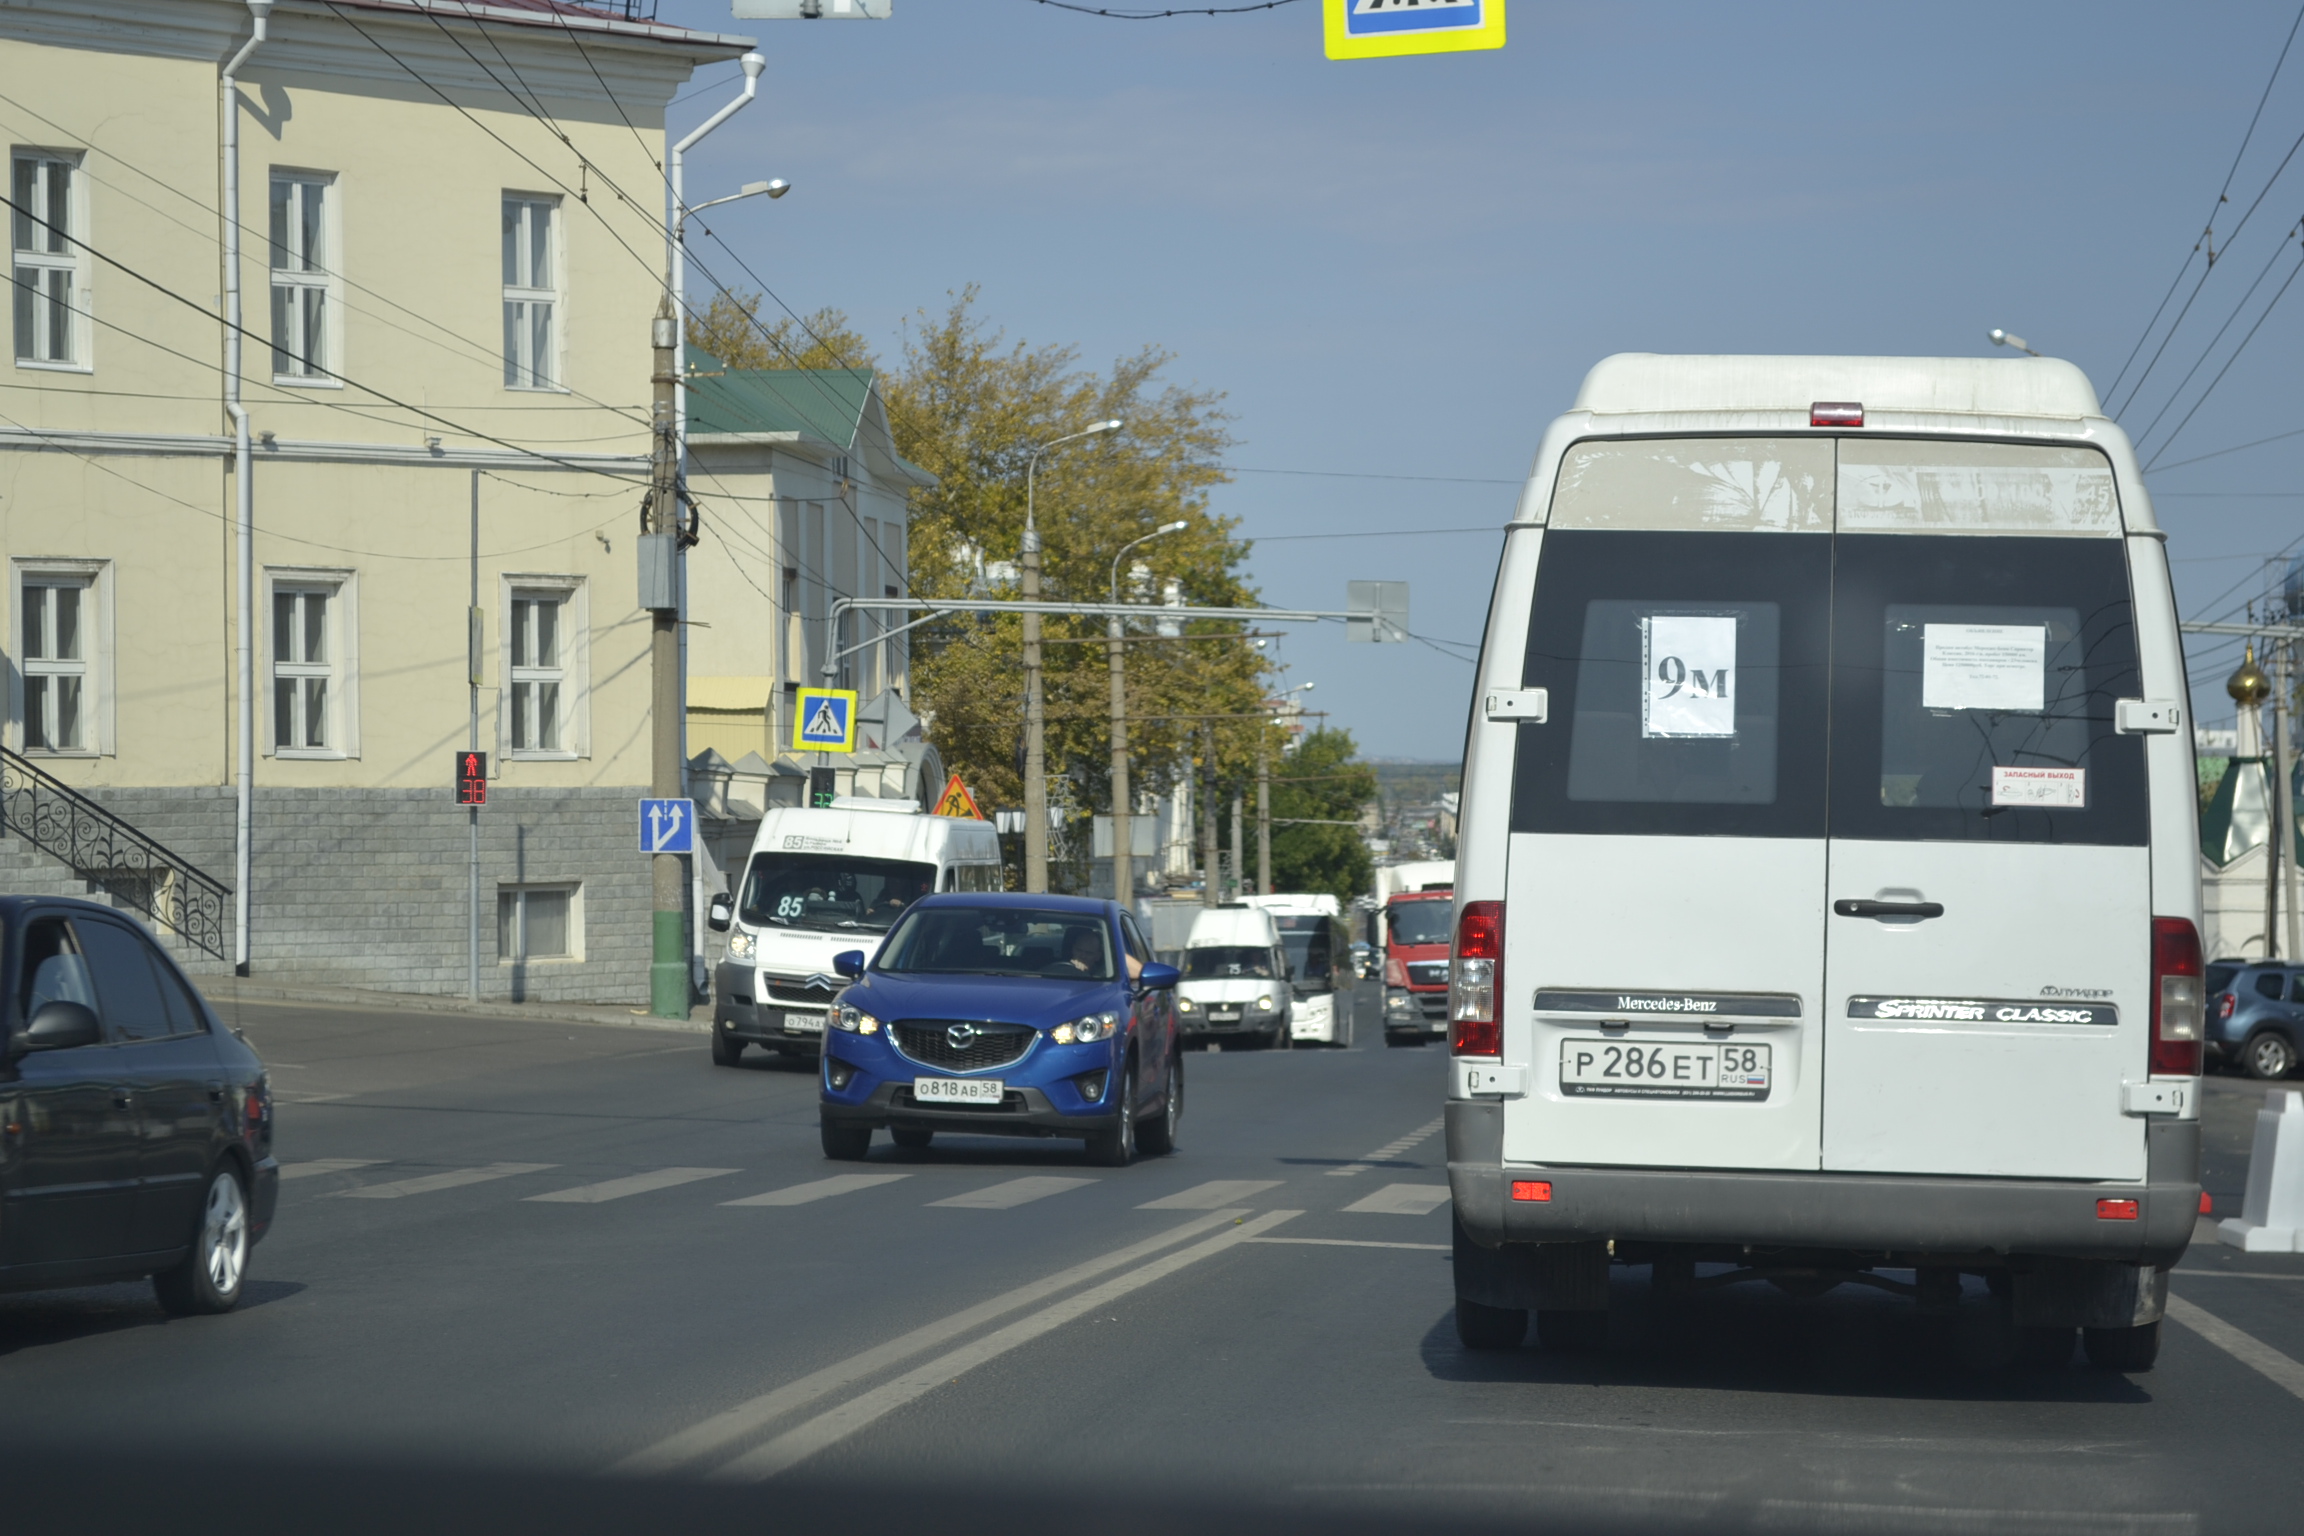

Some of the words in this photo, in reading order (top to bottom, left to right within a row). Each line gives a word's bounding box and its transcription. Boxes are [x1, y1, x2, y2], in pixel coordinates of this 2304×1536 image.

[2003, 771, 2045, 779] ЗАПАСНЫЙ
[2047, 772, 2075, 780] ВЫХОД
[462, 779, 485, 803] 38
[783, 836, 803, 849] 85
[778, 895, 804, 917] 85
[1617, 996, 1717, 1012] Mercedes-Benz
[1996, 1007, 2092, 1023] CLASSIC
[1724, 1048, 1756, 1073] 58
[1721, 1074, 1746, 1084] RUS
[982, 1083, 997, 1094] 58
